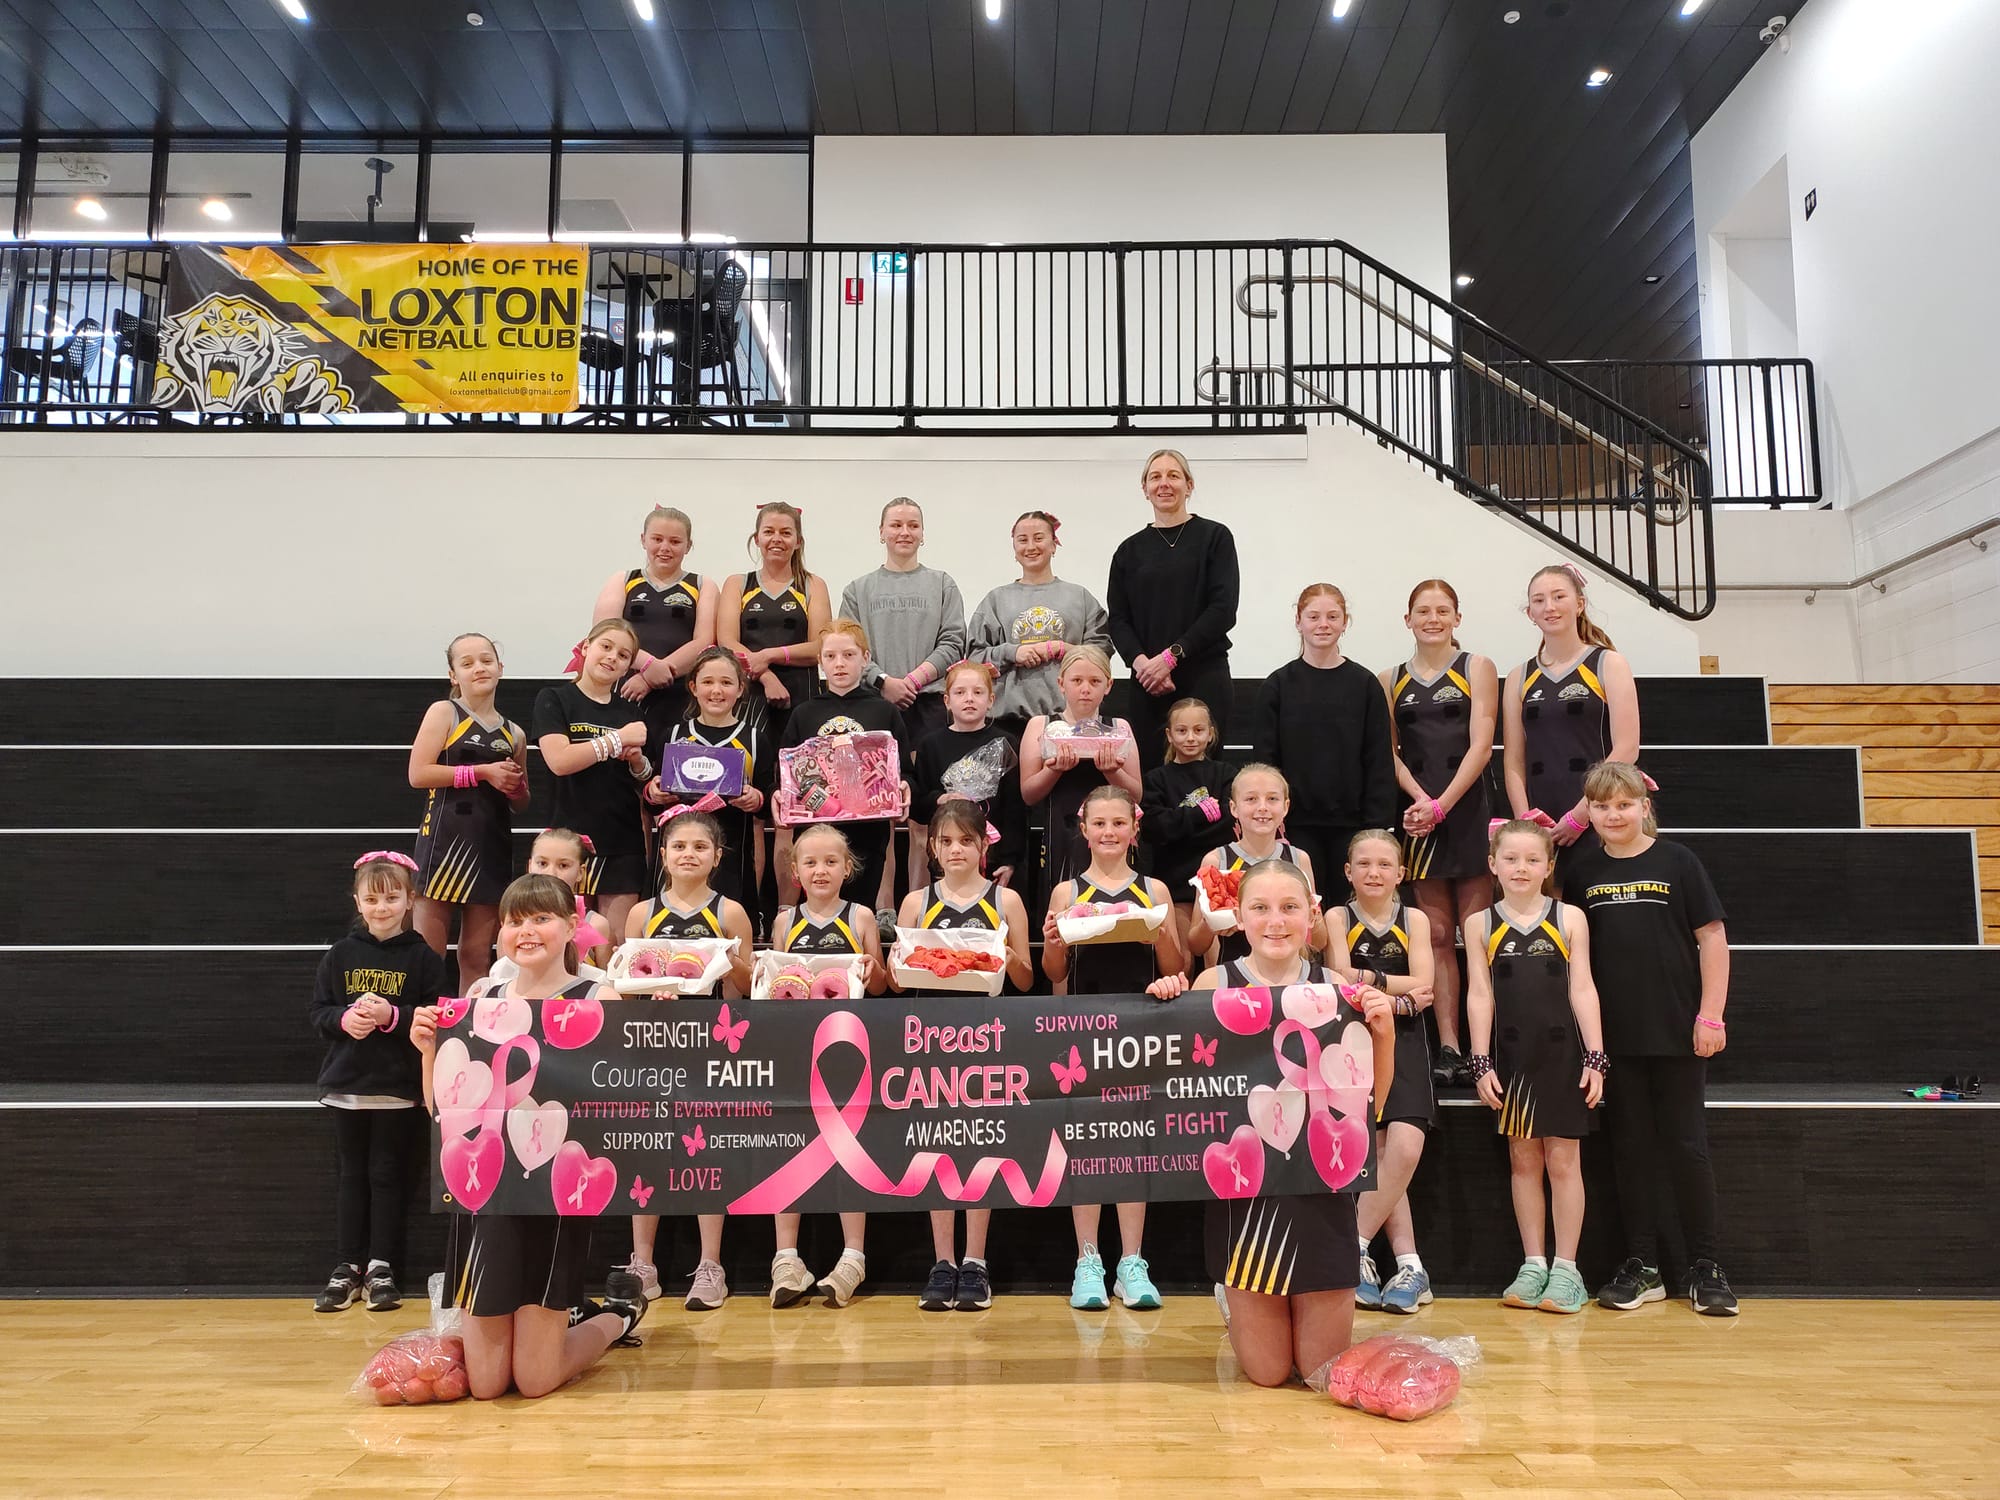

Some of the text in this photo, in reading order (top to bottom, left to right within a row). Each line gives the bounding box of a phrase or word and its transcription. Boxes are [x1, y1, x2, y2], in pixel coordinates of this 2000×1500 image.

[418, 259, 578, 277] HOME OF THE
[359, 287, 578, 326] LOXTON
[358, 327, 577, 350] NETBALL CLUB
[459, 369, 564, 384] All enquiries to
[449, 387, 572, 397] loxtonnetballclub@gmail.com
[570, 725, 600, 735] OXTON
[1612, 892, 1637, 901] CLUB
[1623, 883, 1670, 894] NETBALL
[344, 969, 407, 996] LOXTON
[623, 1020, 710, 1050] STRENGTH
[904, 1014, 1006, 1053] Breast
[1034, 1014, 1119, 1033] SURVIVOR
[1093, 1034, 1183, 1070] HOPE
[591, 1060, 774, 1096] Courage FAITH
[880, 1064, 1031, 1110] CANCER
[1100, 1075, 1249, 1103] IGNITE CHANCE
[570, 1101, 773, 1119] ATTITUDE IS EVERYTHING
[905, 1118, 1006, 1147] AWARENESS
[1065, 1111, 1229, 1141] BE STRONG FIGHT
[603, 1132, 806, 1151] SUPPORT DETERMINATION
[1070, 1153, 1200, 1176] FIGHT FOR THE CAUSE
[669, 1167, 722, 1192] LOVE
